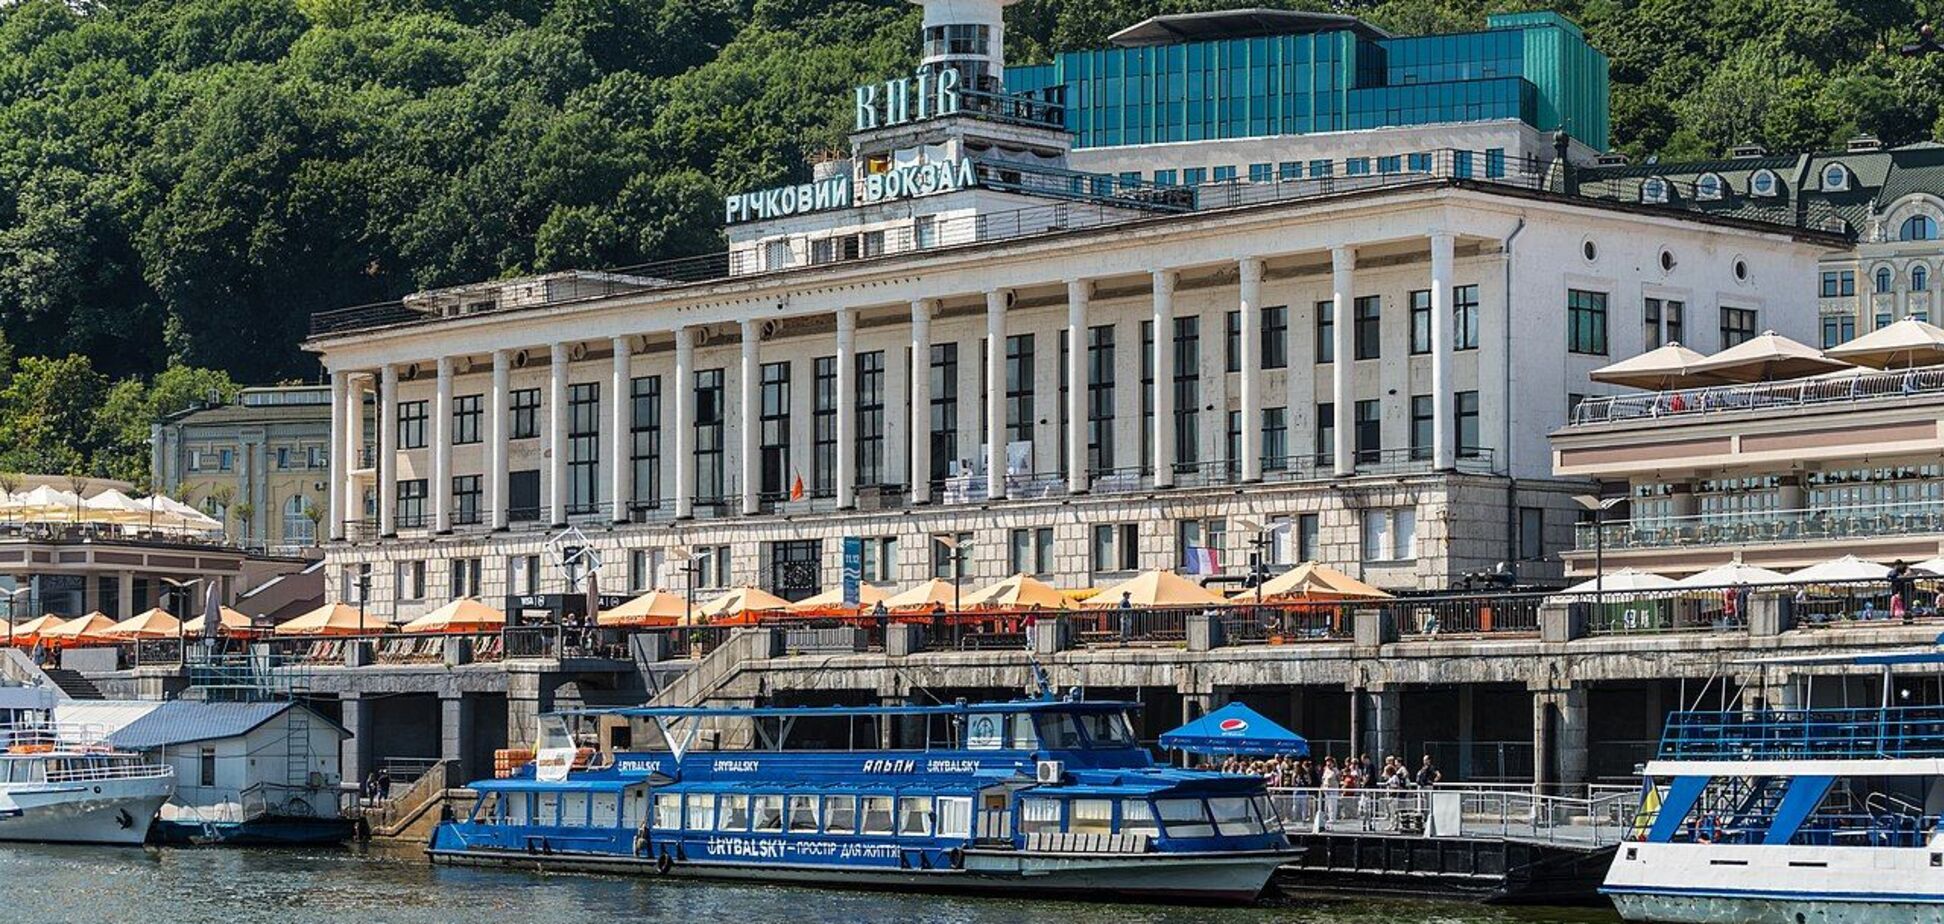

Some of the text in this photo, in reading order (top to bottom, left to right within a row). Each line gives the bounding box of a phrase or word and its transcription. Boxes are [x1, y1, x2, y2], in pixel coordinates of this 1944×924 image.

[856, 68, 960, 130] КИЇВ
[726, 156, 977, 223] РІЧКОВИЙ ВОКЗАЛ
[718, 760, 759, 773] RYBALSKY
[932, 759, 980, 773] RYBALSKY
[716, 837, 787, 858] RYBALSKY
[797, 841, 837, 855] ПРОСТІР
[840, 843, 862, 859] ДЛЯ
